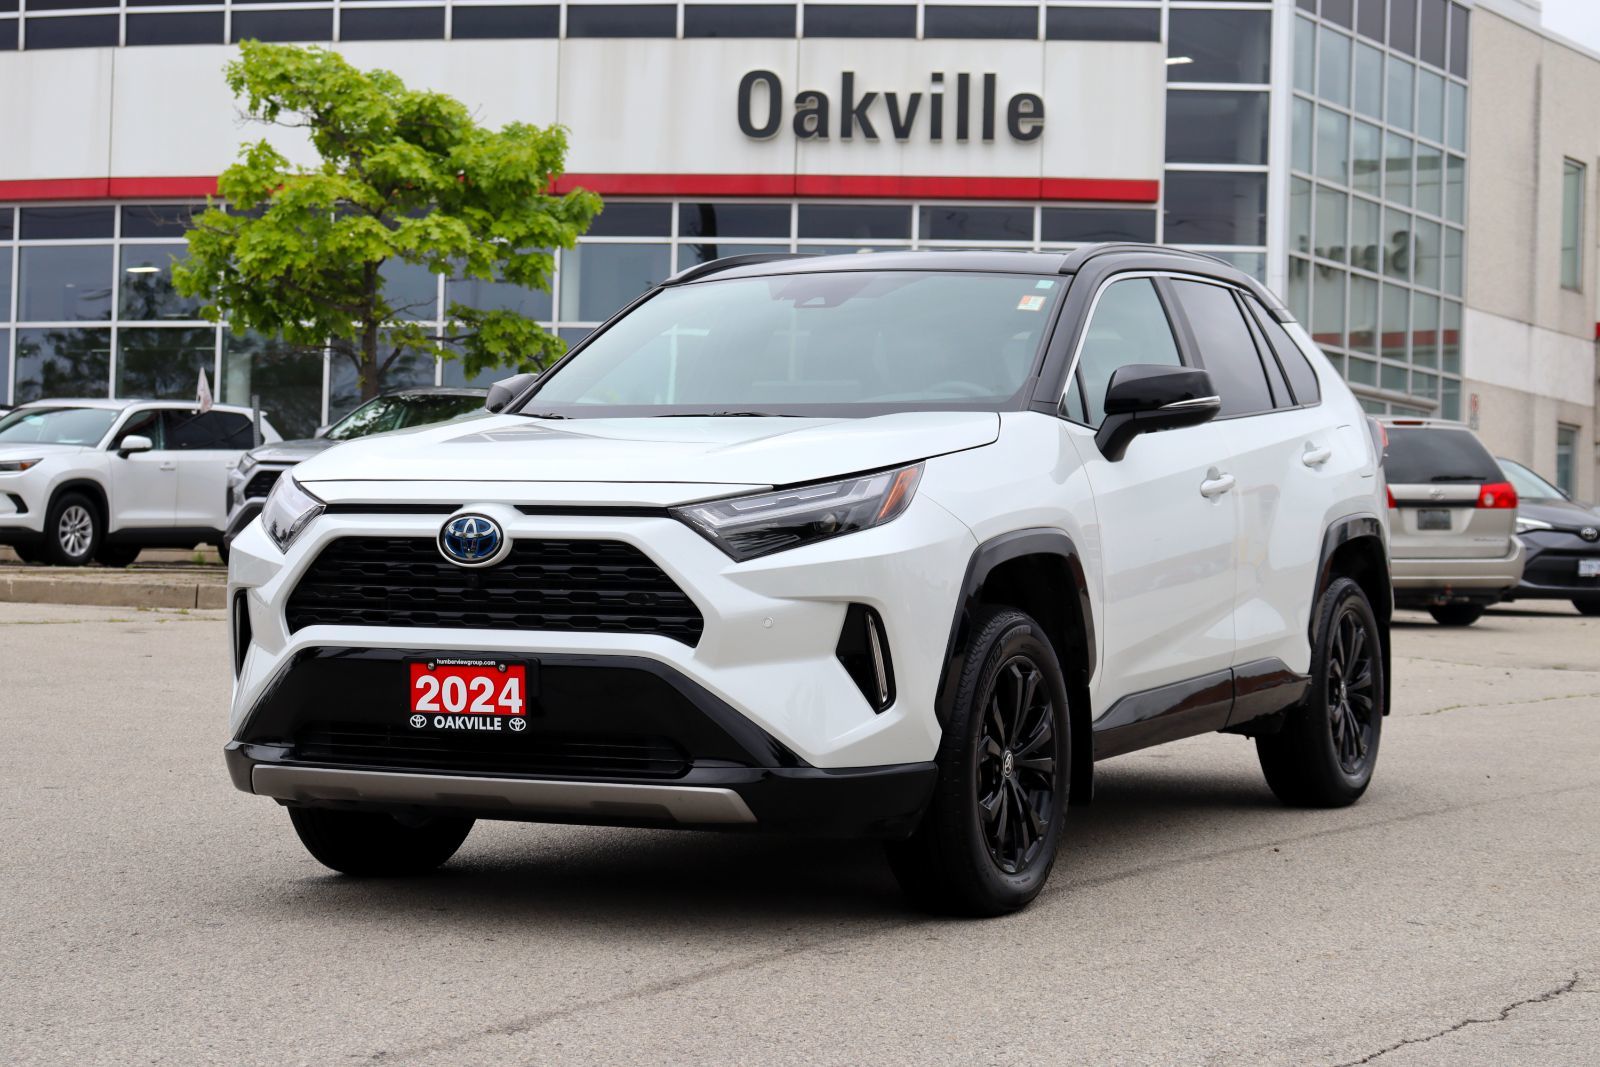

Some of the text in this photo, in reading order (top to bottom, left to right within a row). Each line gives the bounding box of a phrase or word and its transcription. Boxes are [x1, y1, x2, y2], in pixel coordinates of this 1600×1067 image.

[737, 69, 1046, 142] Oakville
[436, 658, 496, 667] humberviewgroup.com
[415, 674, 523, 714] 2024
[433, 715, 502, 731] OAKVILLE
